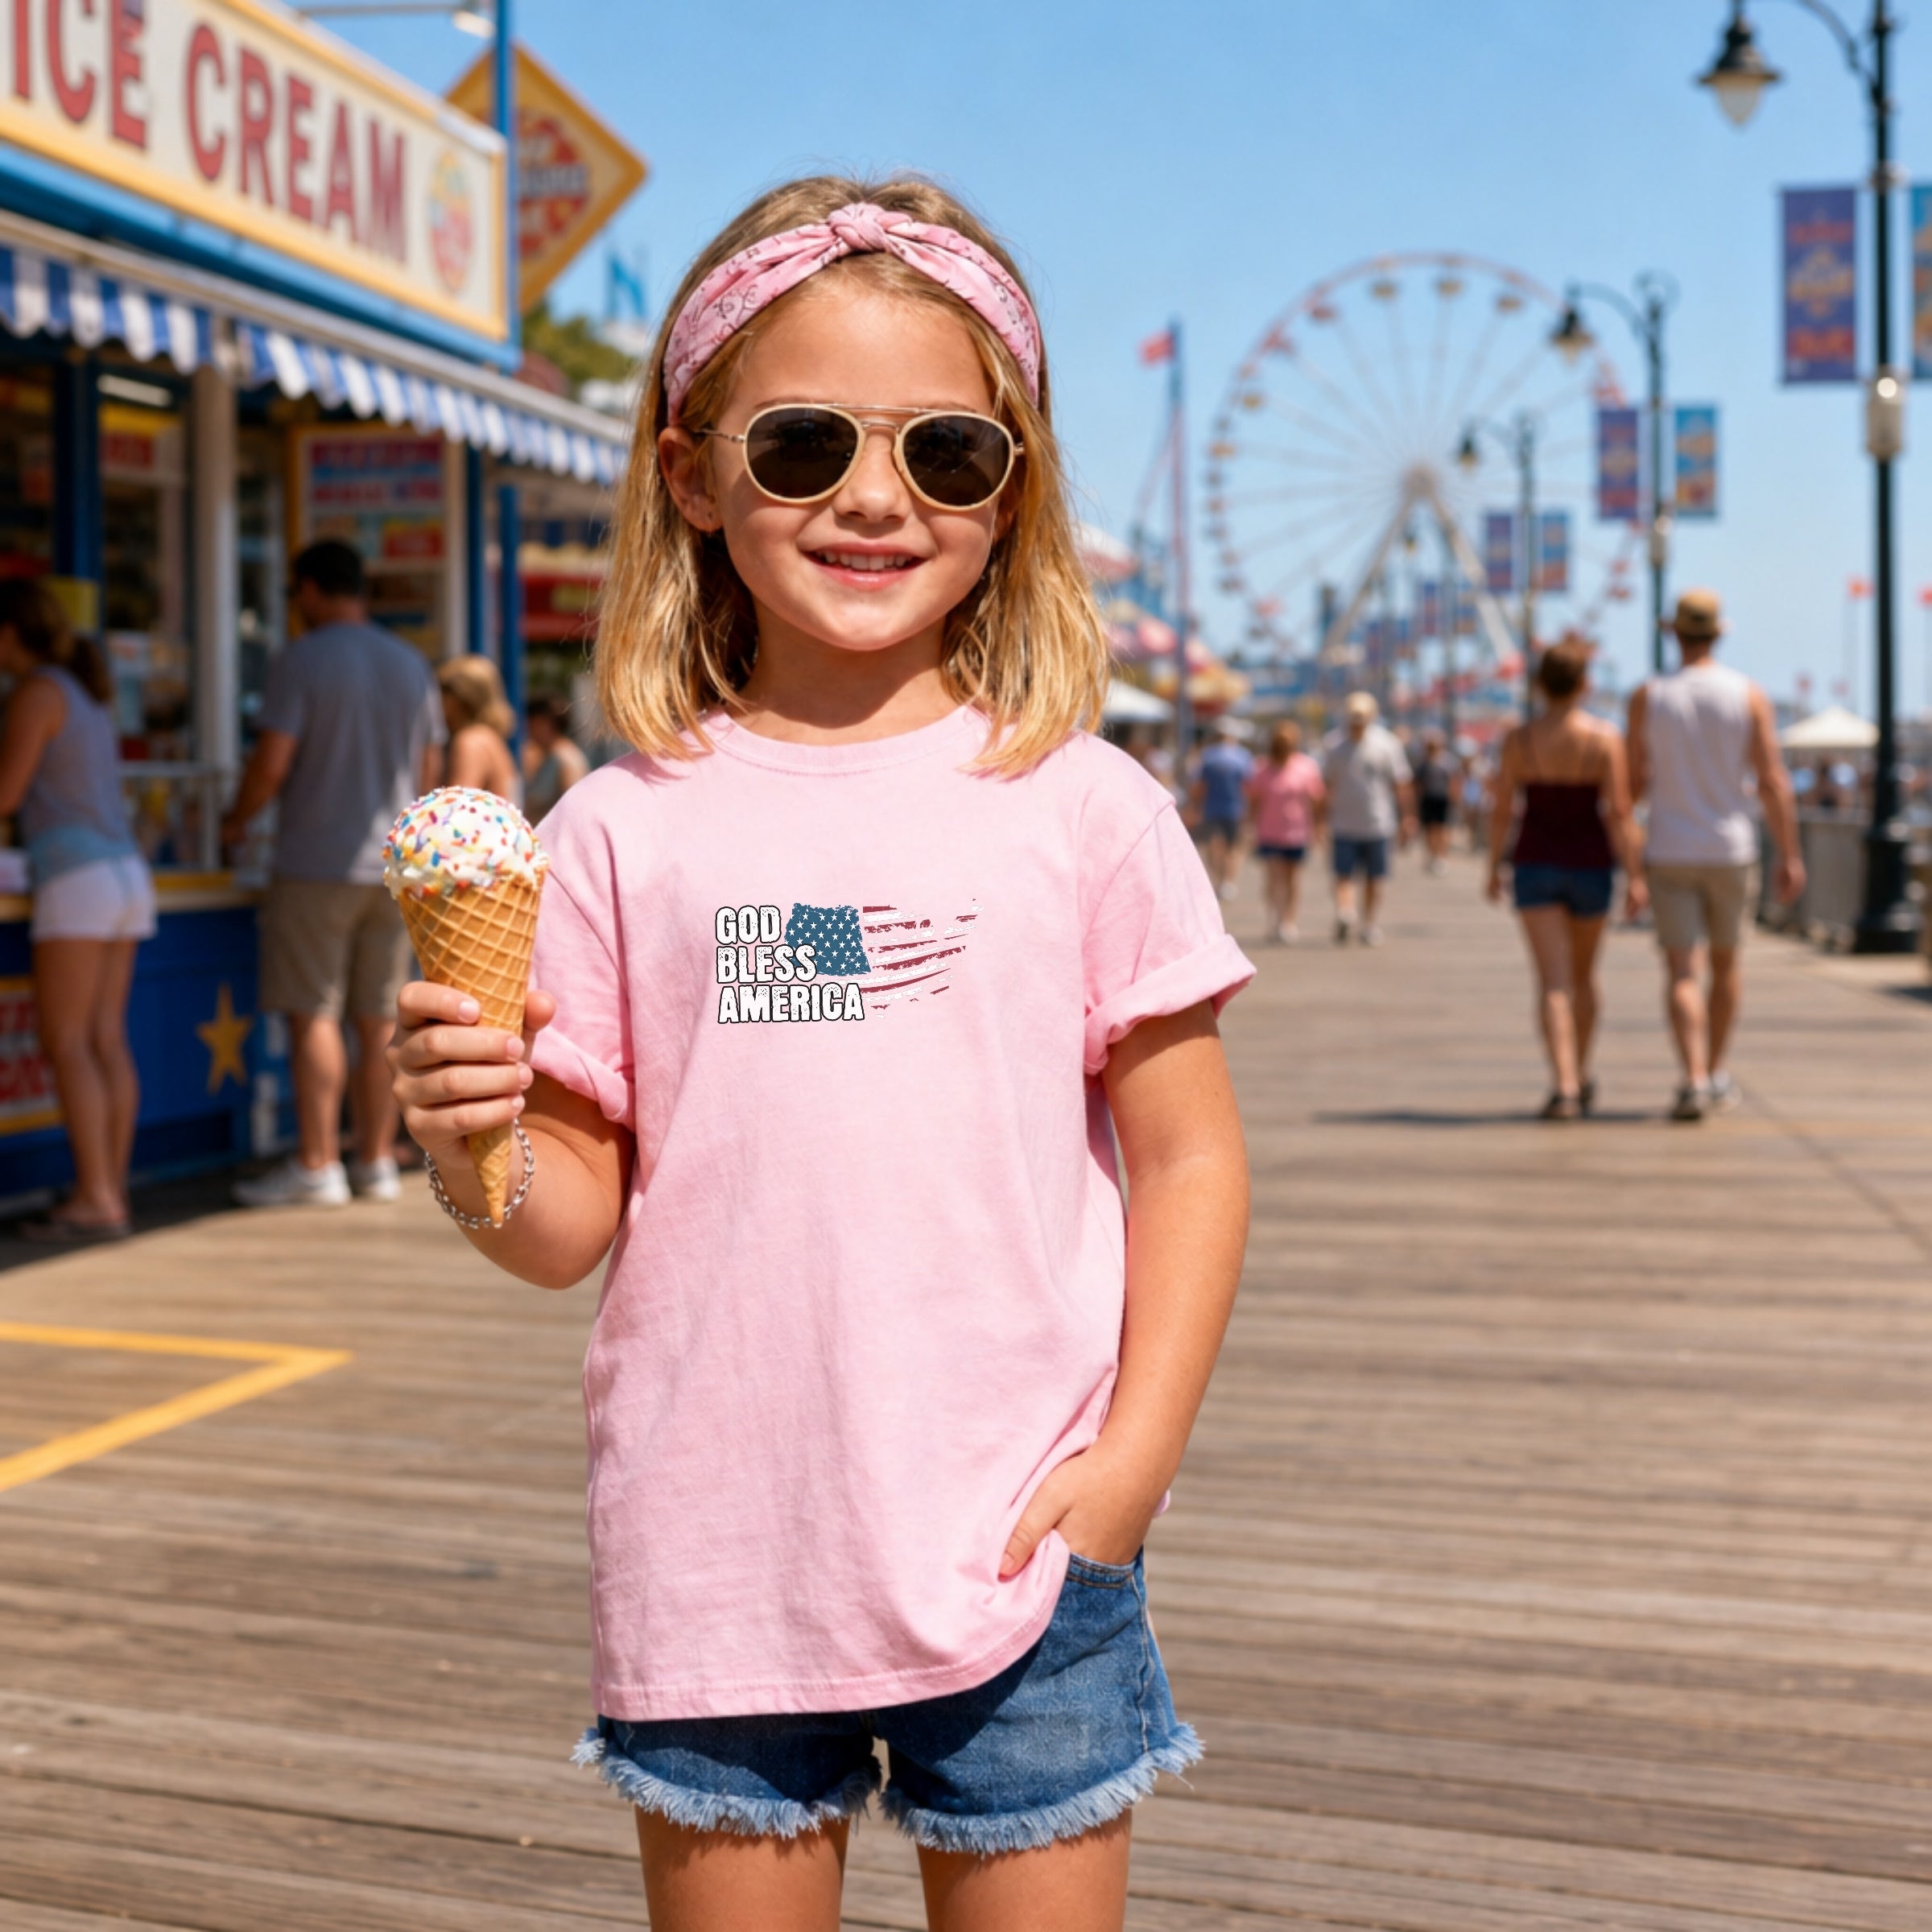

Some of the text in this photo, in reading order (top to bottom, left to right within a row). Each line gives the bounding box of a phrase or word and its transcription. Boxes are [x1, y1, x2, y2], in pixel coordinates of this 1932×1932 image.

[185, 22, 408, 266] CREAM
[715, 905, 782, 944] GOD
[716, 944, 817, 984] BLESS
[718, 983, 865, 1023] AMERICA
